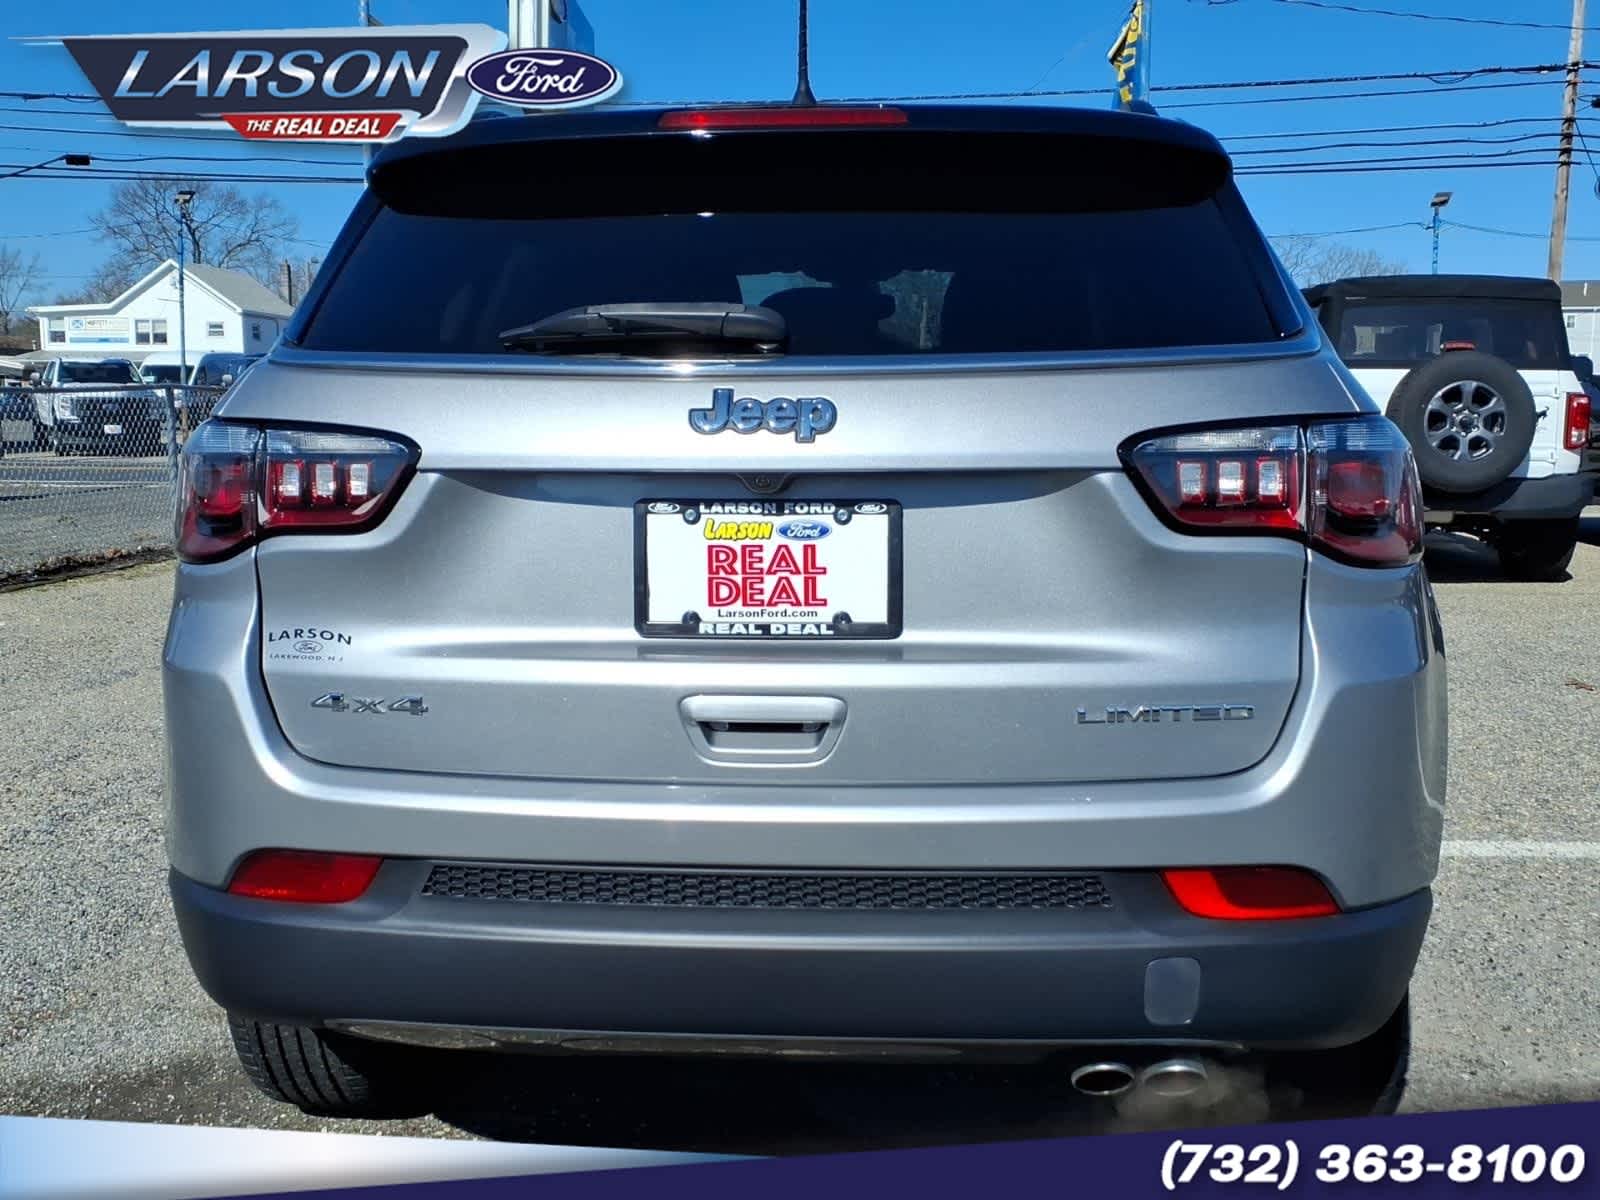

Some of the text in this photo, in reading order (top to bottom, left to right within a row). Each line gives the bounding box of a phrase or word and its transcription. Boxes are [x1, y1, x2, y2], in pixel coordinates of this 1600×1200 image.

[689, 388, 838, 443] Jeep
[700, 503, 836, 514] LARSON FORD
[785, 523, 823, 538] Ford
[707, 545, 827, 575] REAL
[707, 577, 828, 607] DEAL
[717, 609, 818, 618] LarsonFord.com
[268, 628, 352, 645] LARSON
[700, 624, 834, 635] REAL DEAL
[311, 692, 429, 716] 4x4
[1077, 704, 1255, 724] LIMITED
